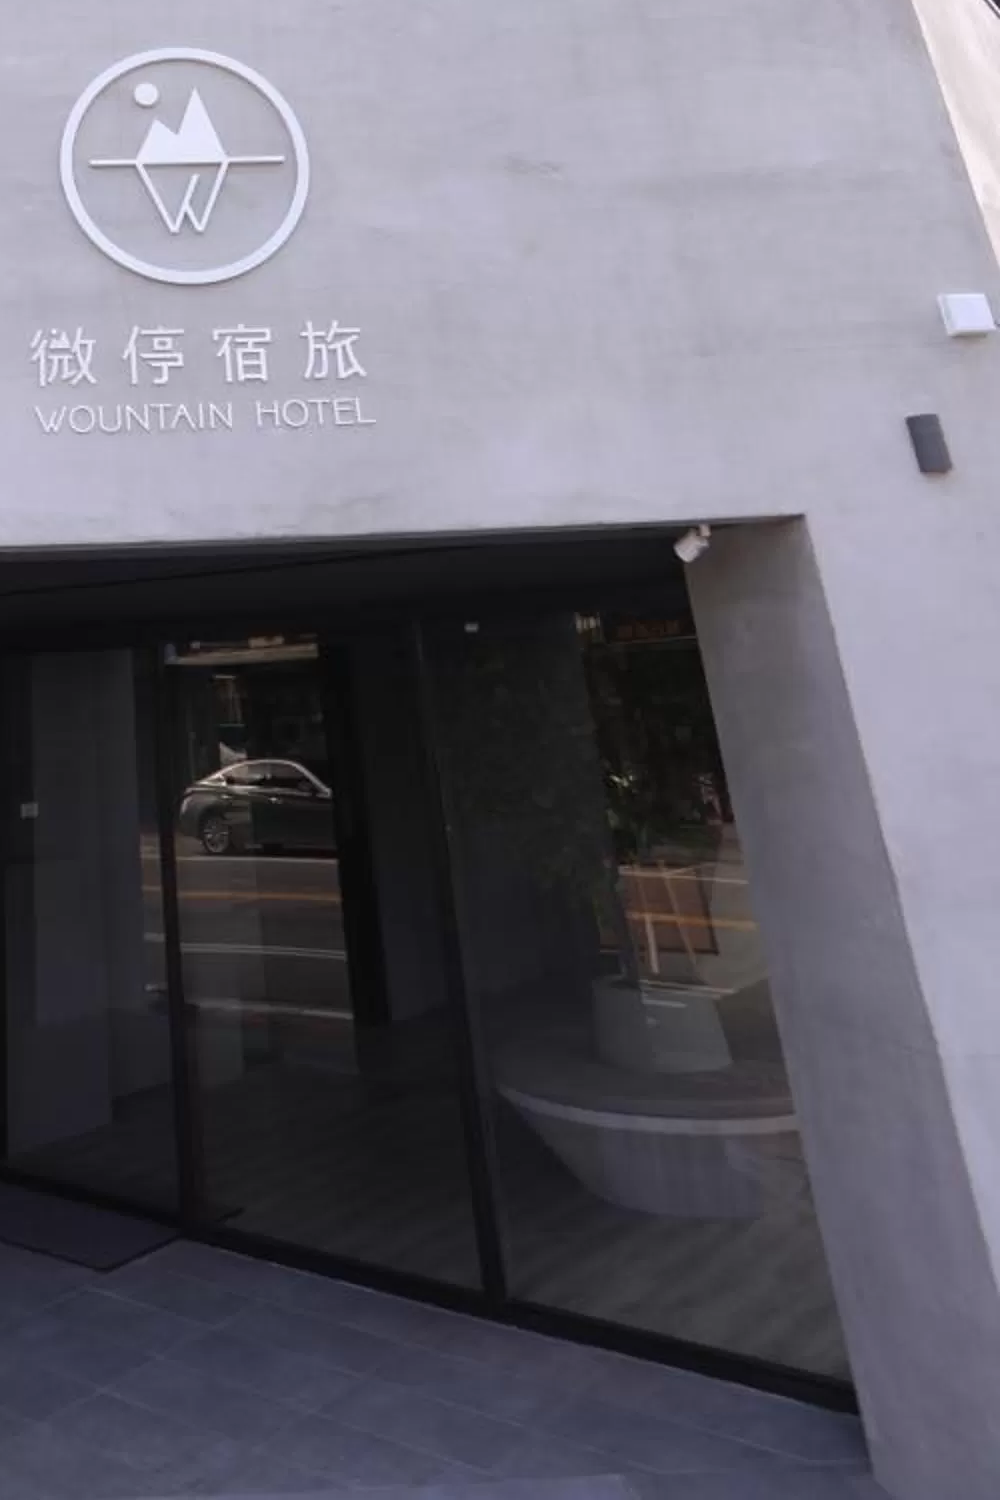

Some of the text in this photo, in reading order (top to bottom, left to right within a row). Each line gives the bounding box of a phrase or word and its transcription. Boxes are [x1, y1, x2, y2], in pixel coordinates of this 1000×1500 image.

[29, 319, 368, 387] 微停宿旅
[34, 396, 377, 433] WOUNTAIN HOTEL
